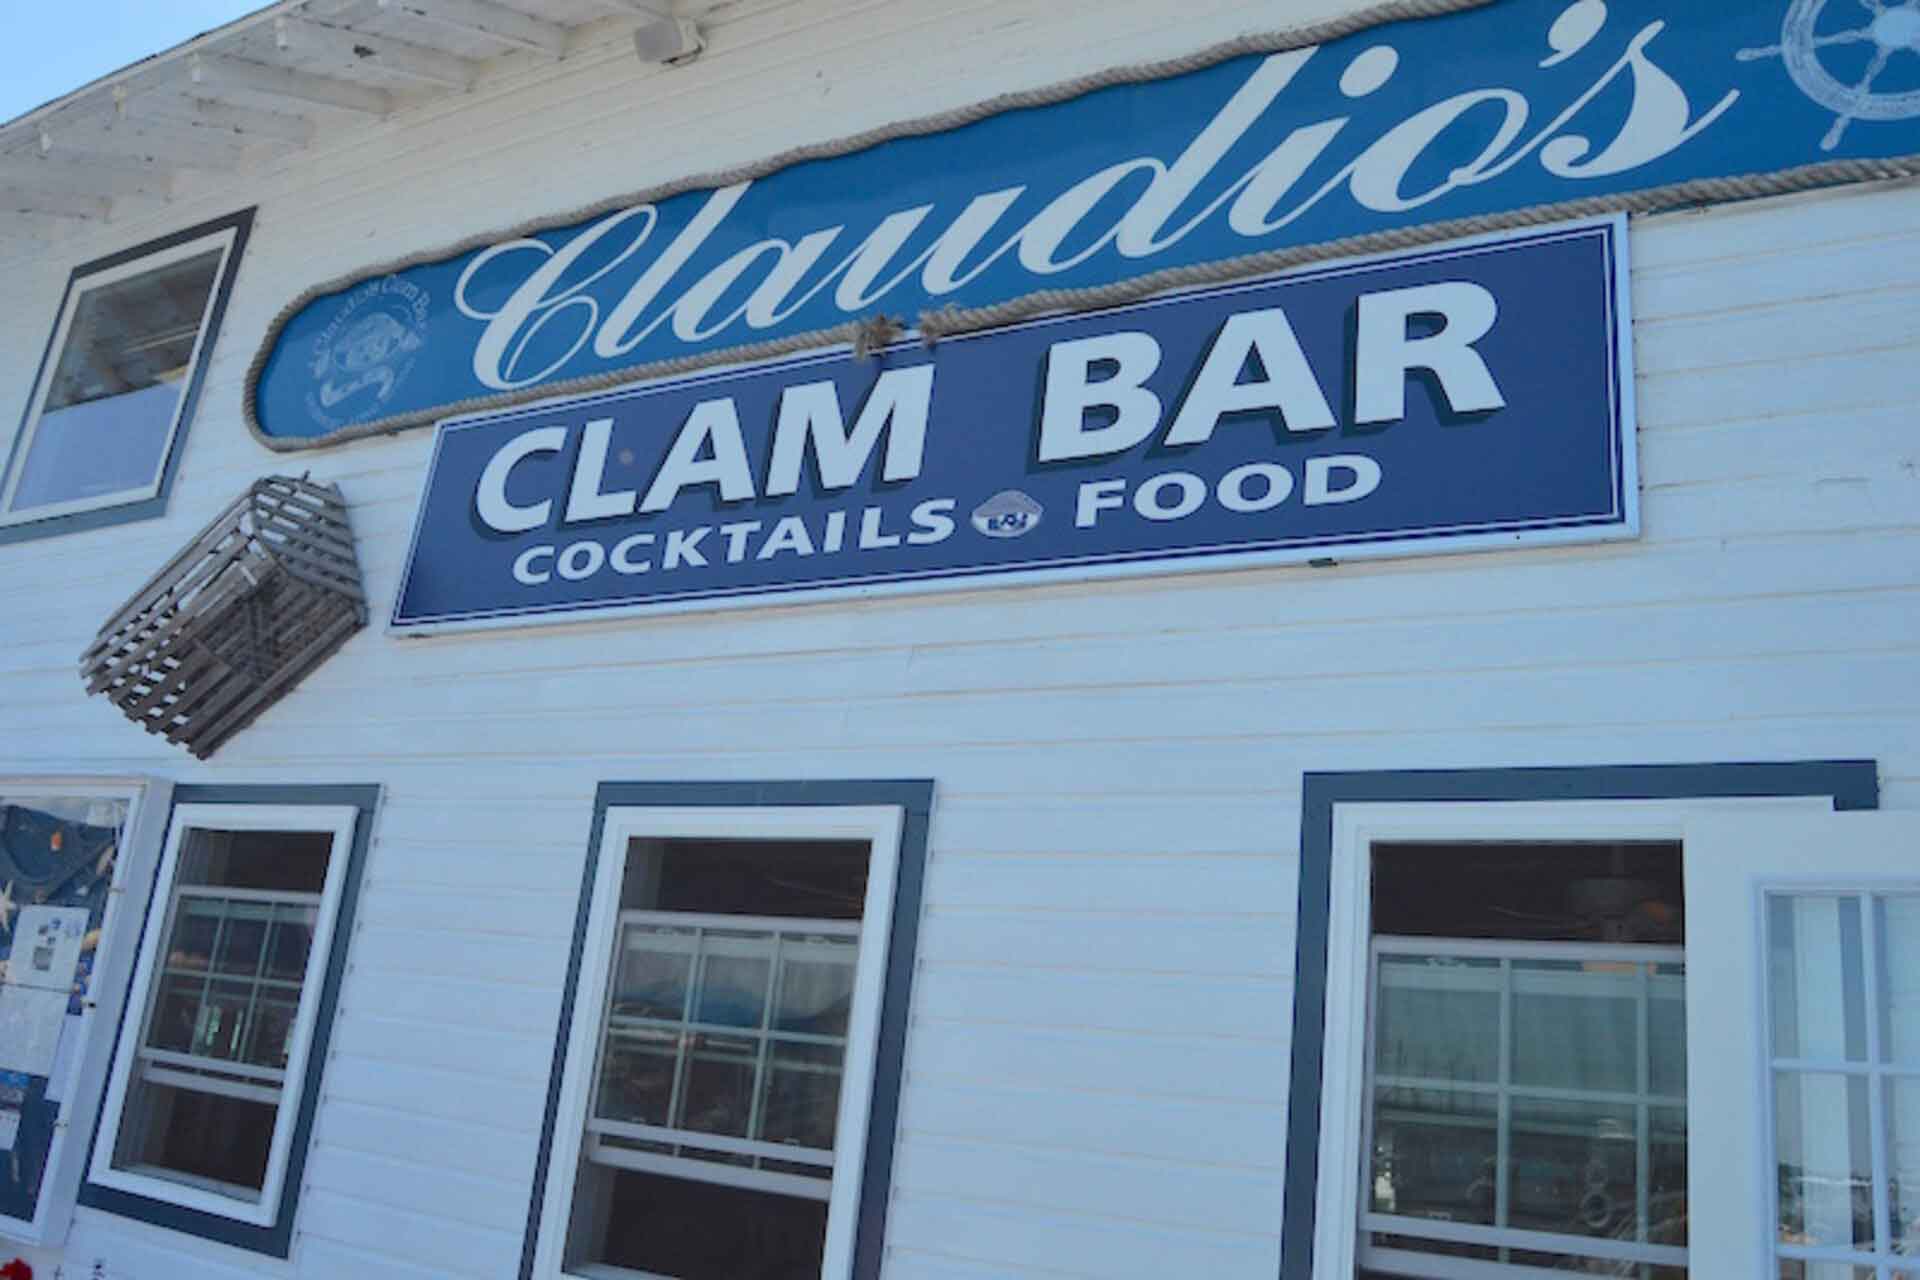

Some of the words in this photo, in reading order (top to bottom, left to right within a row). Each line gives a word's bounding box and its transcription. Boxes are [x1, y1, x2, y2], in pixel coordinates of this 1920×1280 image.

[455, 0, 1739, 390] Claudio's
[477, 363, 935, 532] CLAM
[1039, 280, 1506, 463] BAR
[513, 498, 956, 585] COCKTAILS
[1076, 455, 1381, 528] FOOD
